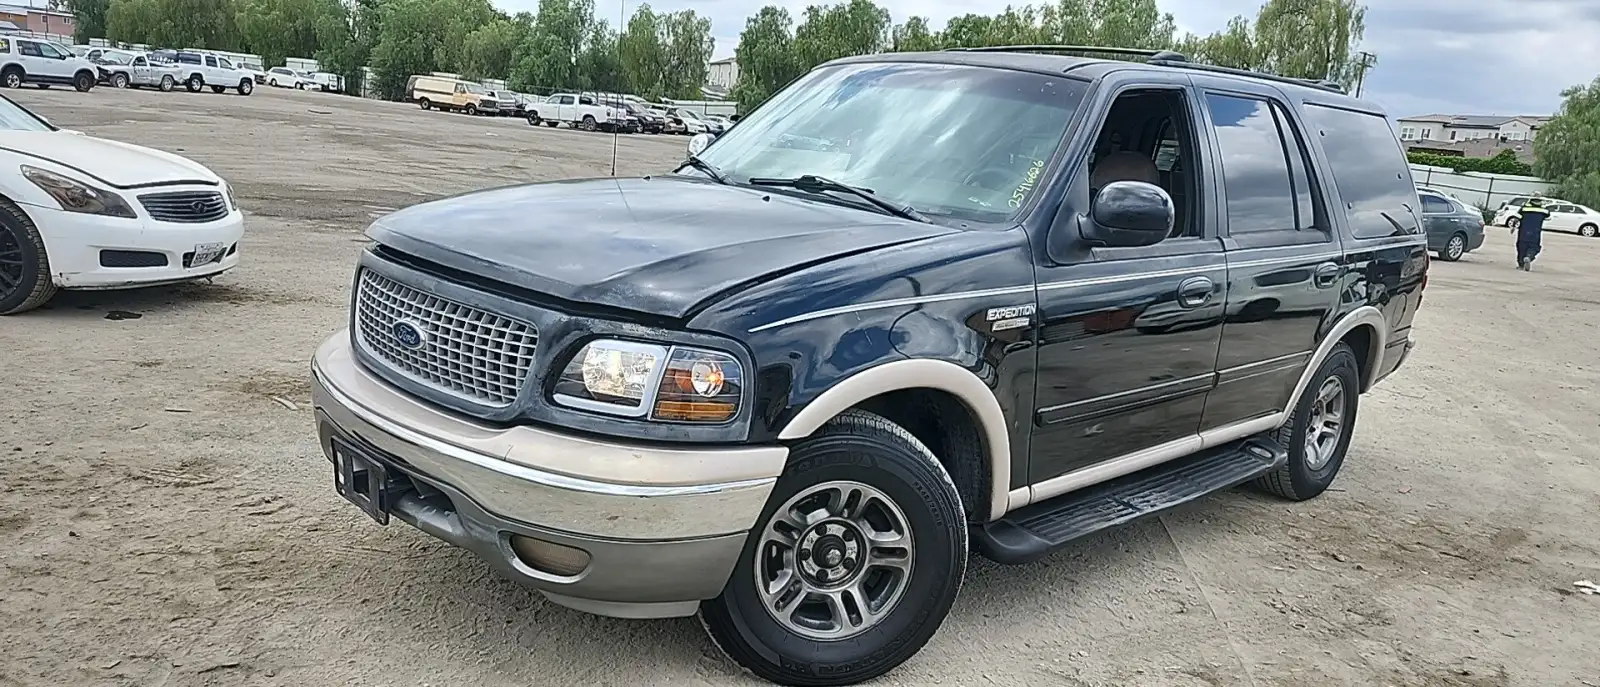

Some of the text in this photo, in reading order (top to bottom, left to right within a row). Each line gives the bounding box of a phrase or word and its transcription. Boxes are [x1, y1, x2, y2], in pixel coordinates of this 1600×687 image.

[1008, 160, 1044, 208] 25416626
[986, 303, 1036, 321] EXPEDITION
[398, 325, 417, 344] Ford
